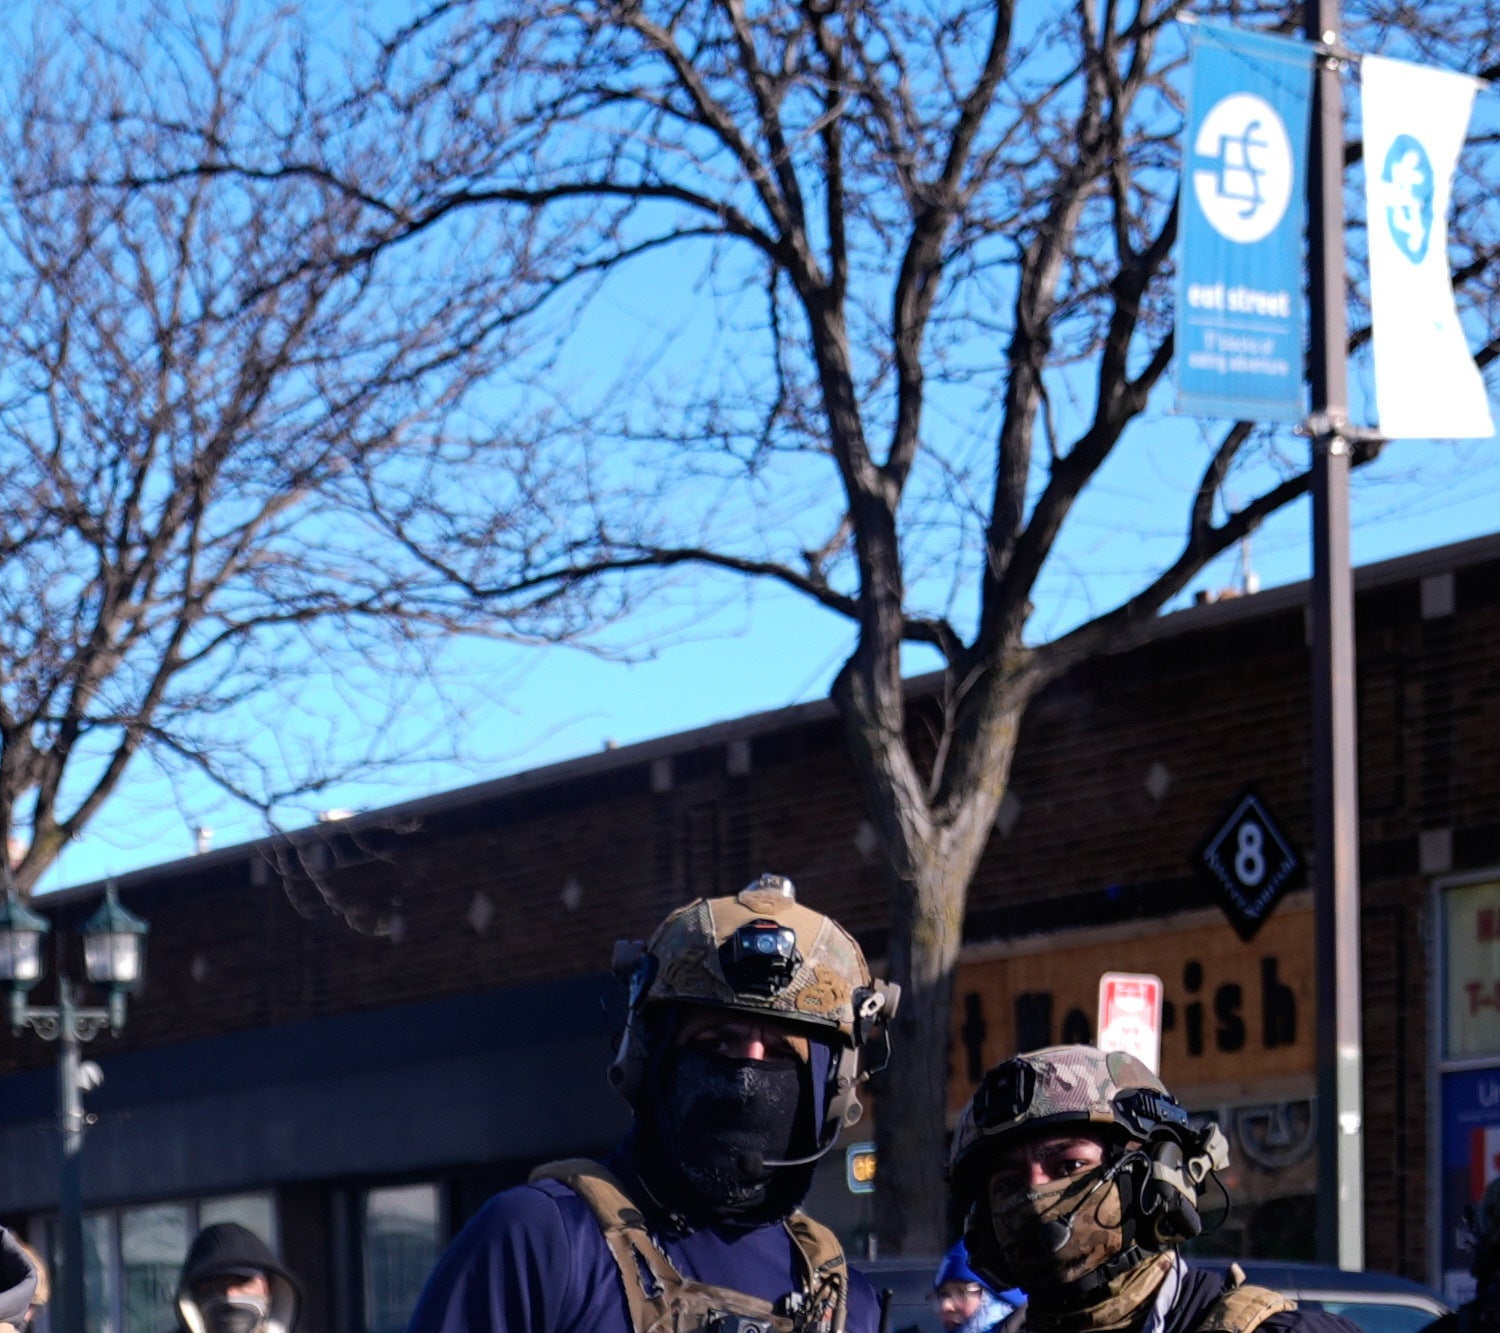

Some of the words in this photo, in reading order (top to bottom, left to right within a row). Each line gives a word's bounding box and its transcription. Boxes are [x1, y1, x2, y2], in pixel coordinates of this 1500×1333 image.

[1188, 282, 1225, 310] eat
[1227, 284, 1290, 318] street
[1233, 819, 1268, 888] 8
